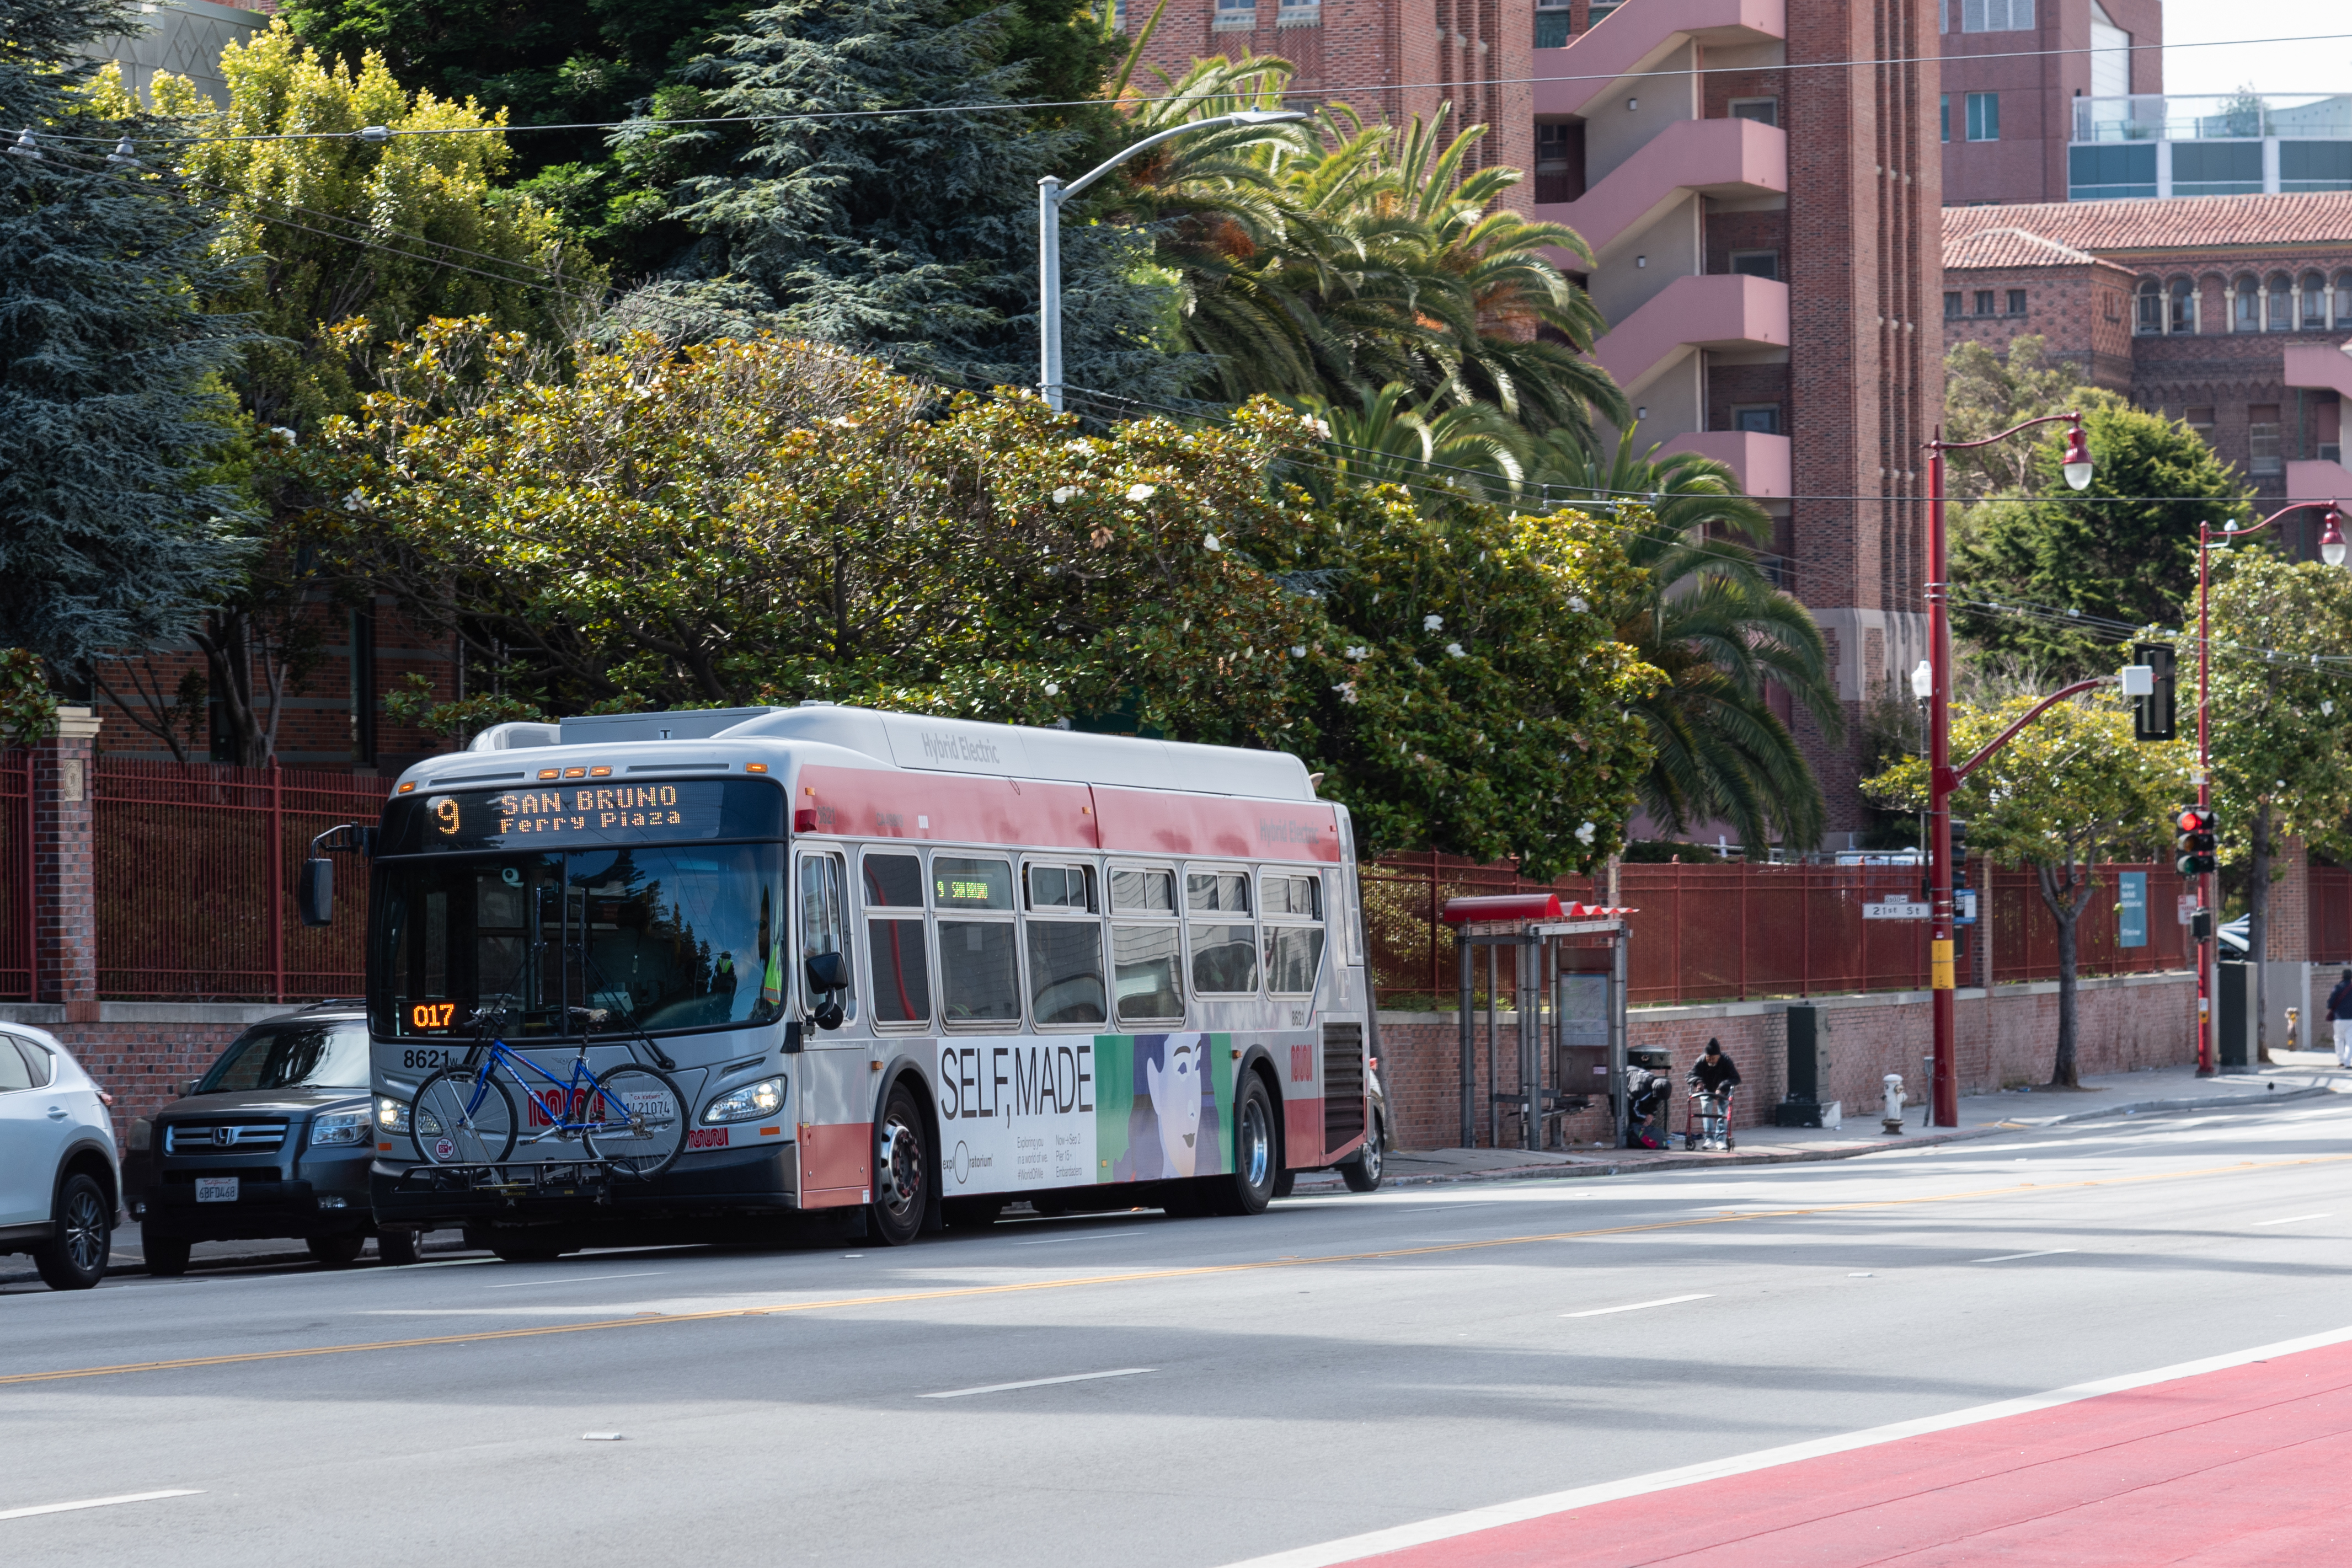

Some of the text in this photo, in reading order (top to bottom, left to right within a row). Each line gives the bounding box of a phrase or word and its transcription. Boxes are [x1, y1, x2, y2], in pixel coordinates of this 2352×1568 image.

[921, 732, 1001, 764] Hybrid Electric
[437, 785, 676, 834] 9 SAN BRUNO
[501, 811, 681, 833] Ferry Plaza
[1260, 818, 1319, 847] Hybrid Electric
[937, 881, 944, 898] 9
[1873, 907, 1920, 915] 21st St
[414, 1004, 454, 1027] 017
[1292, 1011, 1305, 1026] 8621
[404, 1050, 448, 1068] 8621
[941, 1045, 1093, 1130] SELF, MADE
[626, 1101, 670, 1115] 1421074
[1017, 1137, 1035, 1150] Exploring
[1056, 1134, 1065, 1146] Now
[1078, 1133, 1081, 1144] 2
[1017, 1153, 1022, 1164] in
[1025, 1152, 1036, 1164] world
[1036, 1152, 1041, 1163] of
[1056, 1150, 1070, 1162] Pier 15
[1018, 1168, 1044, 1180] #WorldOfWe
[1056, 1166, 1082, 1178] Embarcadero
[199, 1186, 235, 1198] 6BFD468
